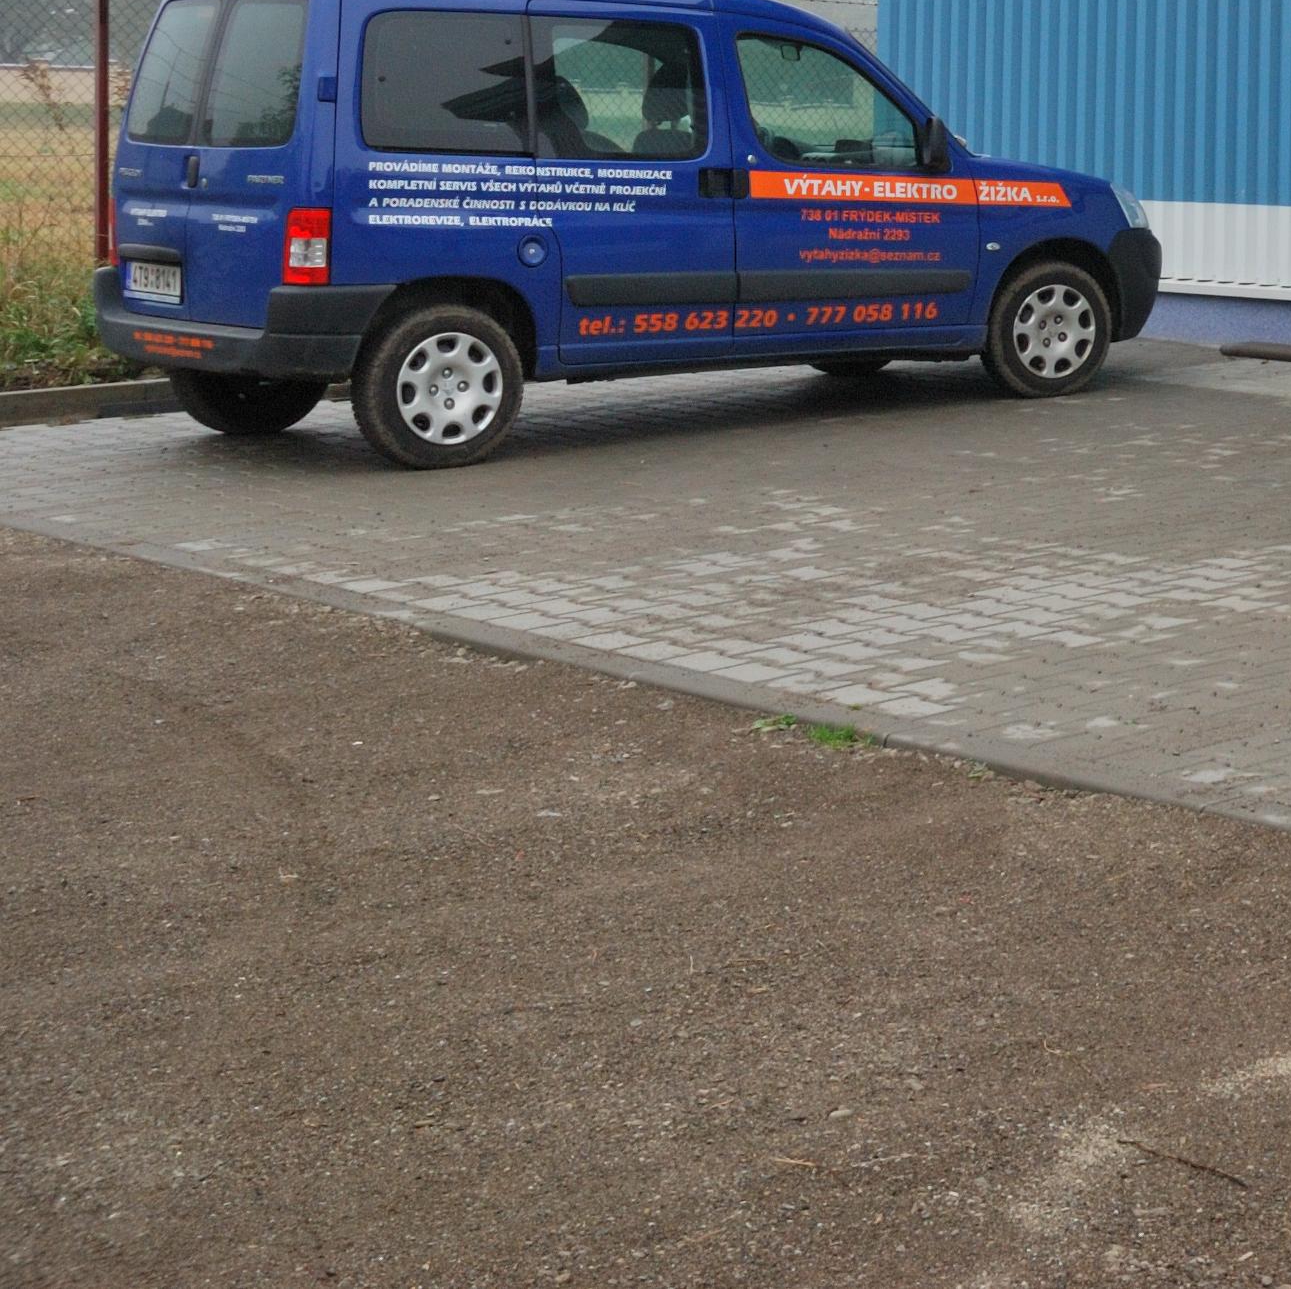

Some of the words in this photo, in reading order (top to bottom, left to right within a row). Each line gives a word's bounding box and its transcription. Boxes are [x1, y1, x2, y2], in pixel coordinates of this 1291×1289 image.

[368, 160, 439, 173] PROVÁDÍME
[441, 162, 501, 176] MONTÁŽE,
[505, 165, 594, 178] REKONSTRUKCE,
[597, 169, 673, 180] MODERNIZACE
[368, 177, 437, 190] KOMPLETNÍ
[439, 181, 477, 192] SERVIS
[480, 179, 516, 192] VŠECH
[609, 184, 667, 196] PROJEKČNÍ
[978, 181, 1033, 203] ŽIŽKA
[1036, 195, 1060, 204] s.r.o.
[368, 197, 379, 208] A
[382, 196, 460, 209] PORADENSKÉ
[462, 197, 515, 210] ČINNOSTI
[519, 200, 527, 210] S
[529, 199, 592, 212] DODÁVKOU
[594, 202, 611, 212] NA
[368, 214, 465, 227] ELEKTROREVIZE,
[469, 215, 553, 227] ELEKTROPRÁCE
[801, 209, 822, 222] 738
[824, 210, 839, 222] 01
[578, 317, 625, 335] tel.:
[633, 314, 678, 333] 558
[684, 311, 729, 330] 623
[734, 310, 777, 328] 220
[806, 307, 846, 325] 777
[853, 304, 893, 323] 058
[901, 302, 938, 320] 116
